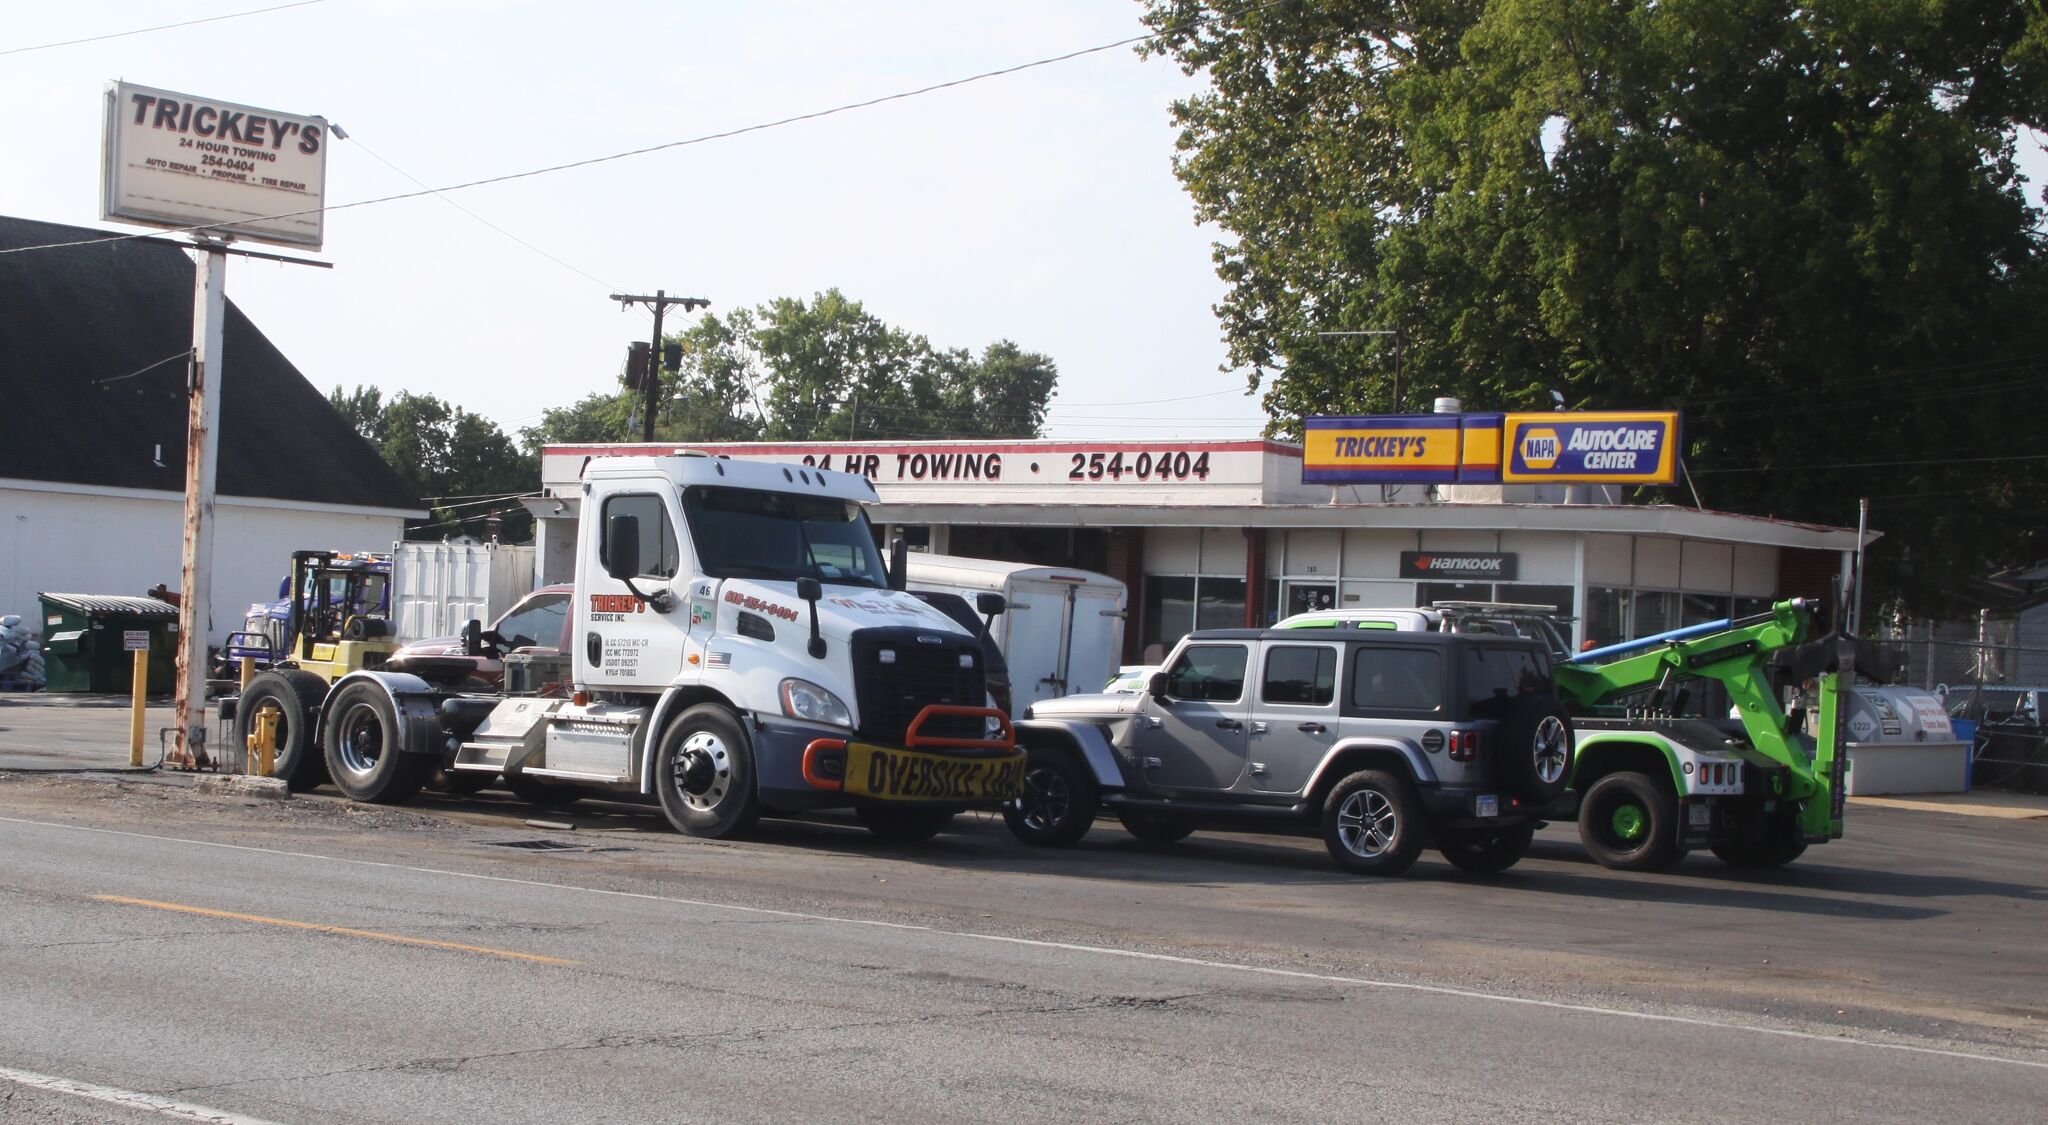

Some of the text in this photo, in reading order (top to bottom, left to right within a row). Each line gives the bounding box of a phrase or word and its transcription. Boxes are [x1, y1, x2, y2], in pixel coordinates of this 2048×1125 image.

[131, 93, 321, 155] TRICKEY'S
[179, 138, 277, 162] 24 HOUR TOWING
[201, 154, 255, 172] 254-0404
[145, 157, 306, 191] AUTO REPAIR PROPANE TIRE REPAIR
[1335, 436, 1426, 459] TRICKEY'S
[1526, 439, 1555, 459] NAPA
[845, 454, 880, 481] HR
[896, 453, 1002, 481] TOWING
[1069, 451, 1210, 481] 254-0404
[1583, 451, 1637, 470] CENTER
[699, 585, 711, 596] 46
[590, 594, 645, 613] TRICKEY'S
[725, 590, 799, 622] 618-254-0404
[590, 613, 626, 622] SERVICE INC.
[605, 649, 613, 657] ICC
[613, 649, 621, 657] MC
[605, 659, 620, 667] USDOT
[868, 751, 981, 797] OVERSIZE
